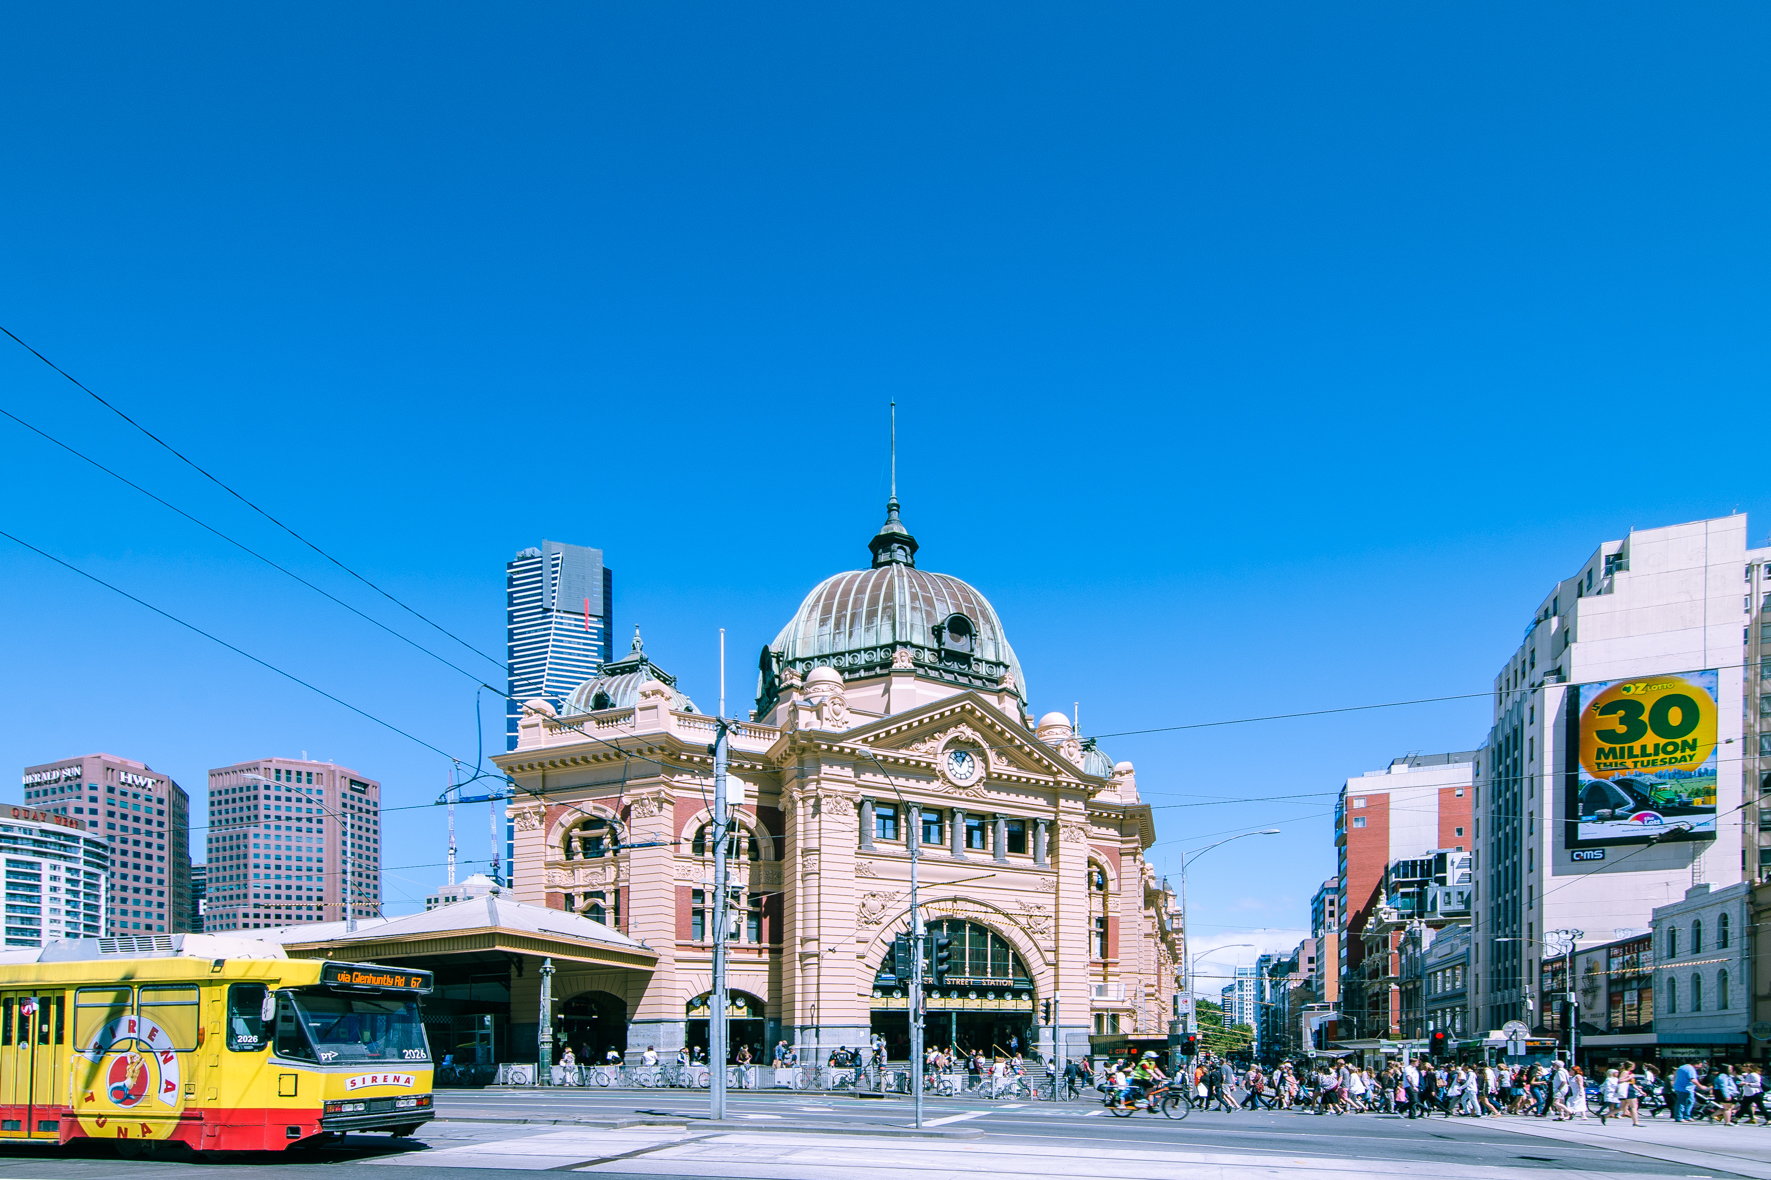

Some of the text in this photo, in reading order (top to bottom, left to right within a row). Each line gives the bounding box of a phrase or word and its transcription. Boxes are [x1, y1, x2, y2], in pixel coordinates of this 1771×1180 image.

[1621, 682, 1675, 696] OZ LOTTO
[1595, 738, 1698, 761] MILLION
[1594, 753, 1697, 770] THIS TUESDAY
[22, 765, 82, 785] HERALD SUN
[119, 770, 158, 789] HWT
[11, 807, 79, 829] QUAY WEST
[337, 971, 405, 987] via Glenhuntly Rd
[410, 977, 422, 988] 67
[946, 978, 1014, 987] STREET STATION
[237, 1035, 258, 1043] 2026
[93, 1019, 177, 1094] SIRENA
[402, 1049, 427, 1059] 2026
[350, 1075, 412, 1088] SIRENA
[84, 1091, 153, 1139] TUNA
